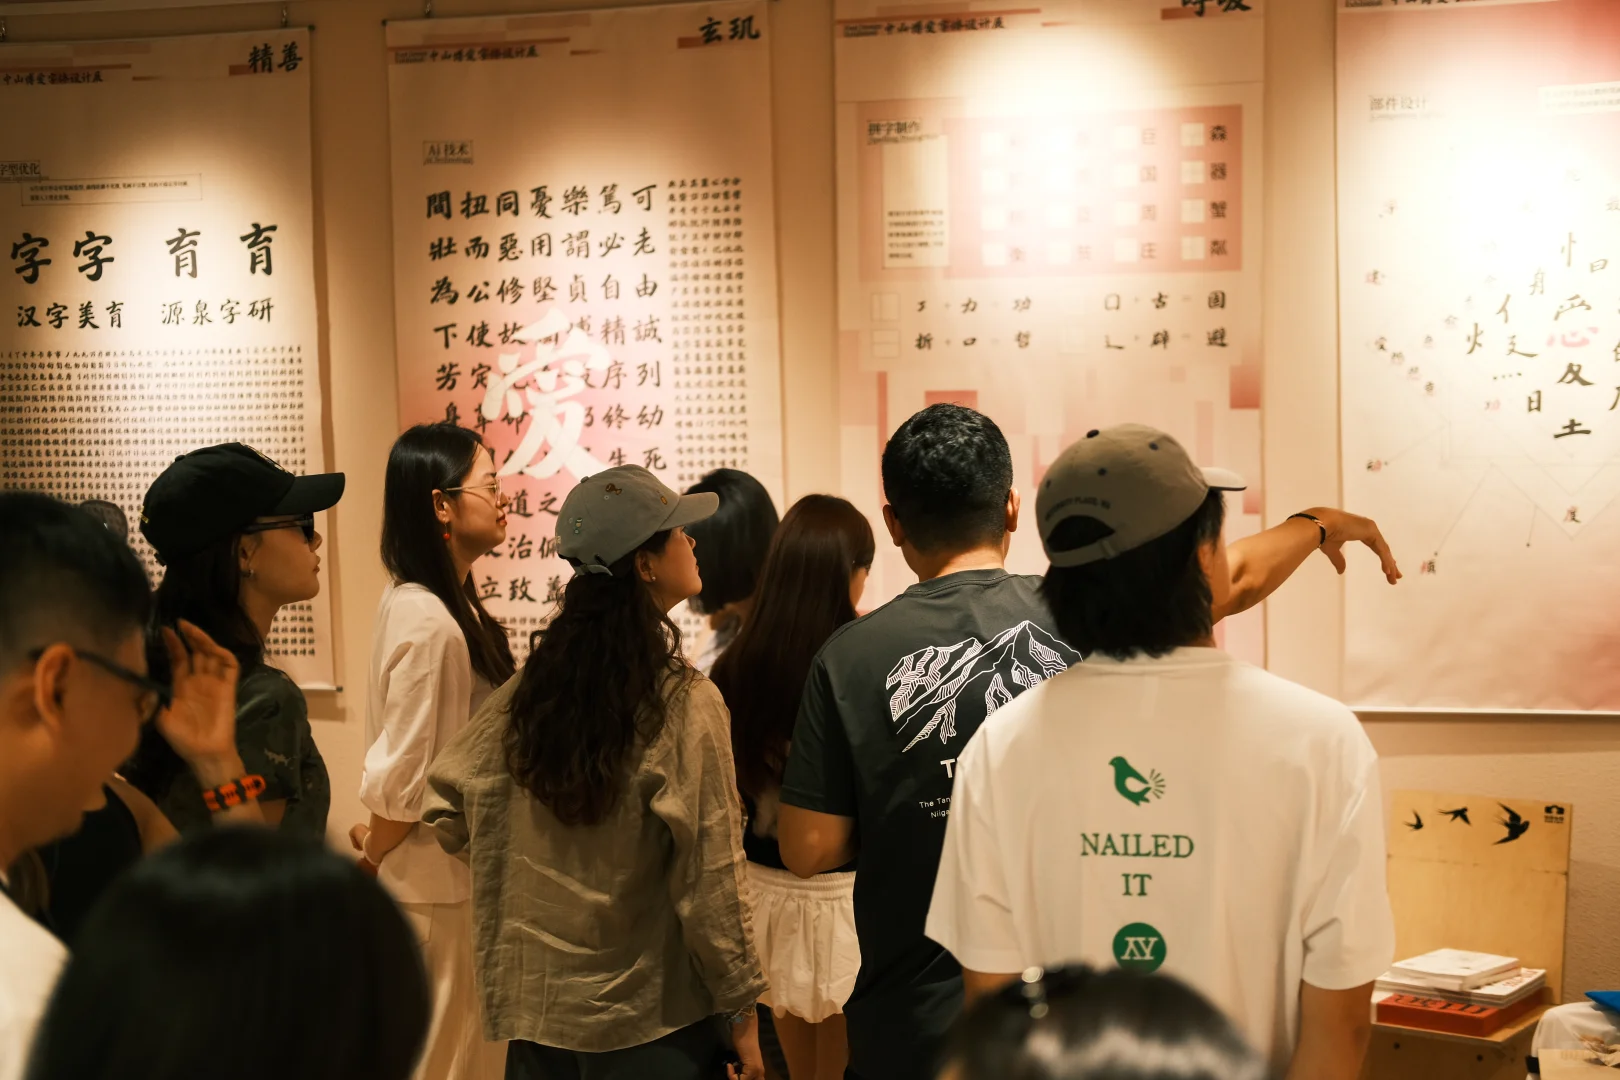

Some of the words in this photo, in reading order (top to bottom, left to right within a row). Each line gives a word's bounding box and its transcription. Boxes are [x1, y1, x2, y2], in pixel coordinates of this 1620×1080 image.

[248, 41, 303, 74] 精善
[16, 300, 125, 330] 汉字美育
[160, 297, 275, 326] 源泉字研
[919, 801, 935, 809] The
[1080, 832, 1195, 859] NAILED
[1121, 873, 1153, 897] IT
